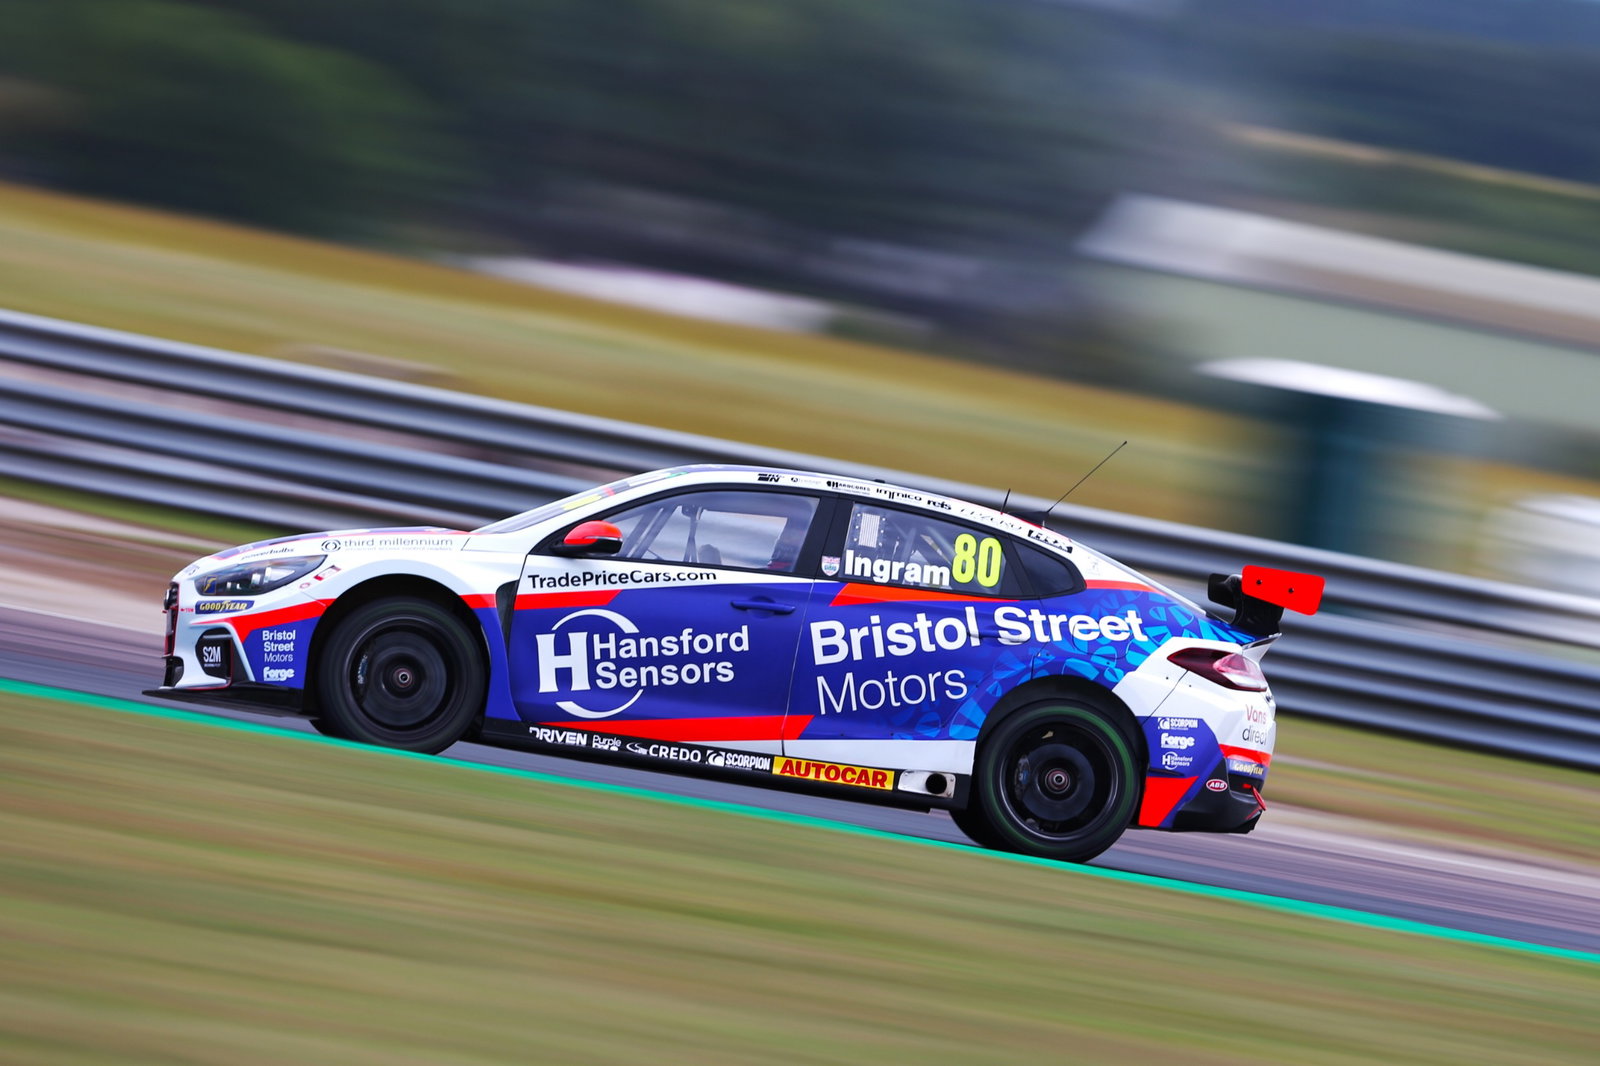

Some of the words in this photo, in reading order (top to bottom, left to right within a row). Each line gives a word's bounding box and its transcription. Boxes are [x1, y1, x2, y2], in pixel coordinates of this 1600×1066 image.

[344, 538, 374, 547] third
[380, 538, 453, 546] millennium
[845, 550, 950, 586] Ingram
[952, 533, 1002, 587] 80
[528, 570, 717, 588] TradePriceCars.com
[262, 629, 296, 641] Bristol
[593, 625, 749, 660] Hansford
[810, 606, 980, 665] Bristol
[994, 607, 1148, 645] Street
[203, 646, 221, 662] S2M
[263, 641, 294, 651] Street
[264, 653, 293, 662] Motors
[535, 631, 591, 693] H
[595, 661, 735, 689] Sensors
[816, 668, 967, 715] Motors
[1245, 704, 1267, 724] Vans
[649, 744, 702, 762] CREDO
[725, 752, 770, 770] SCORPION
[779, 759, 888, 788] AUTOCAR
